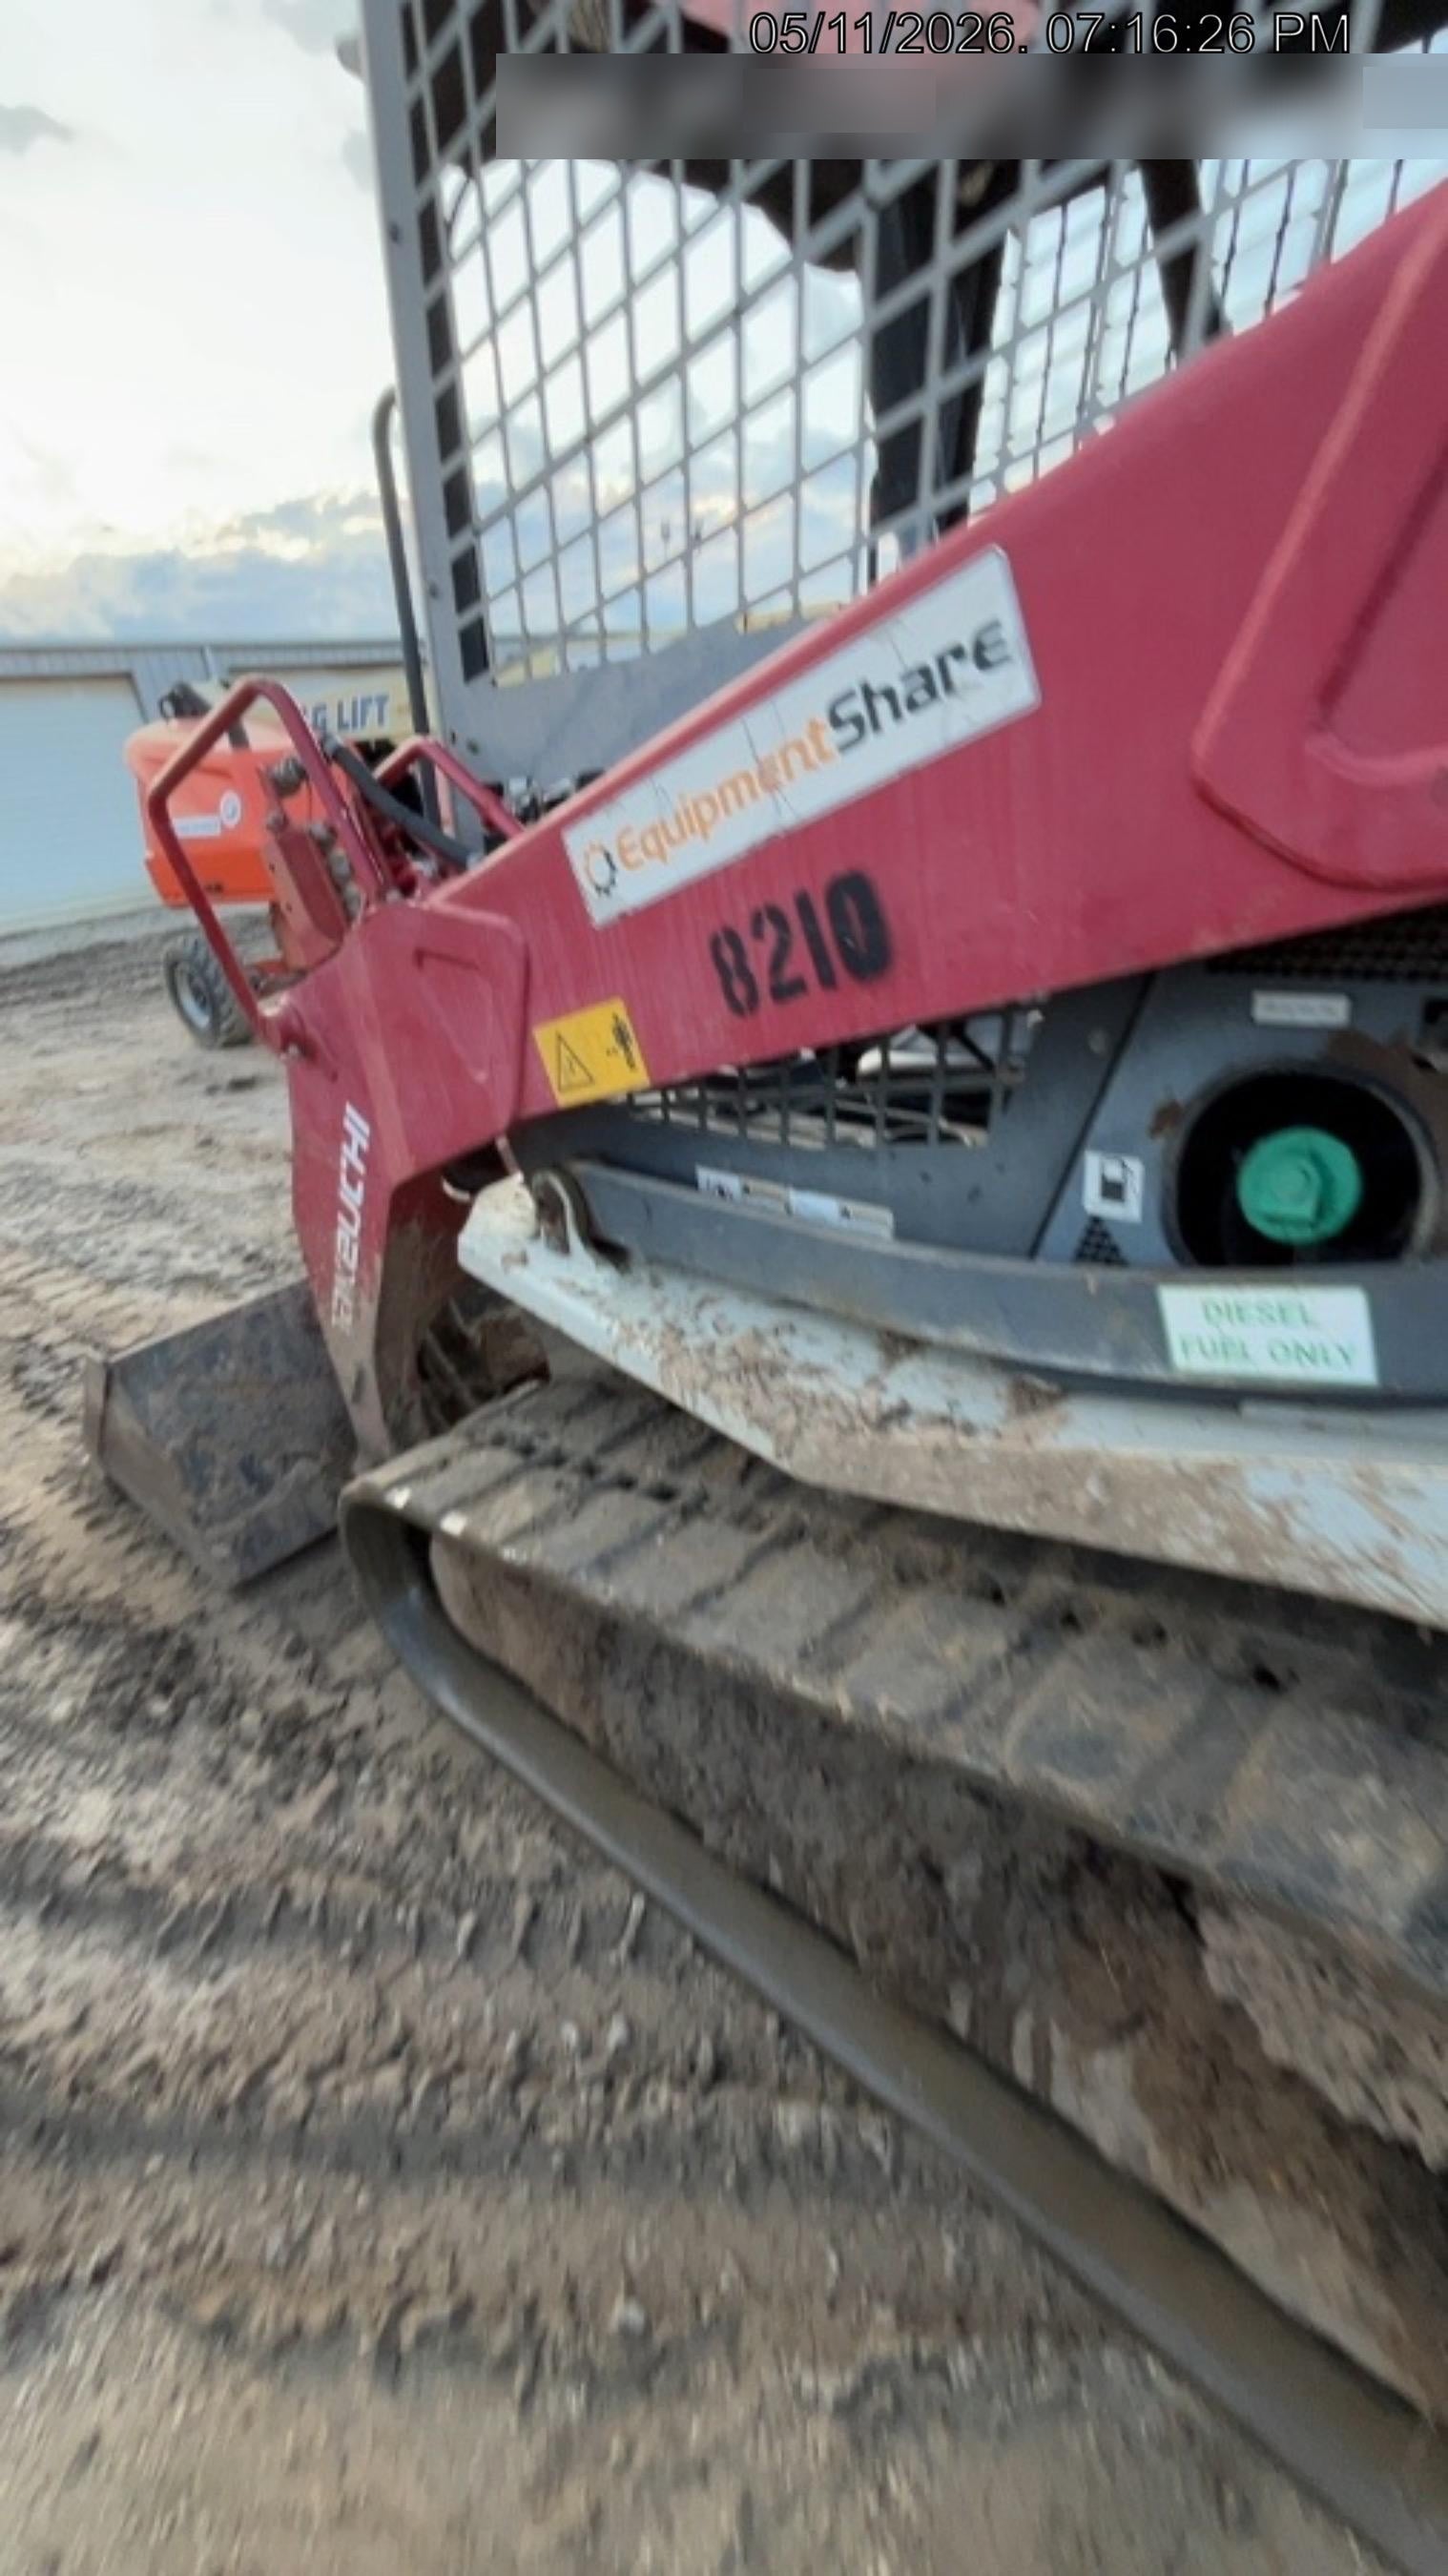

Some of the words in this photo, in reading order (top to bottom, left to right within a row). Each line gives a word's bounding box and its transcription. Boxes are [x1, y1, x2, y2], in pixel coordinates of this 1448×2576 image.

[338, 691, 389, 731] LIFT
[615, 618, 1014, 869] EquipmentShare
[709, 869, 893, 1017] 8210
[1200, 1298, 1320, 1328] DIESEL
[1179, 1337, 1258, 1366] FUEL
[1267, 1340, 1357, 1368] ONLY
